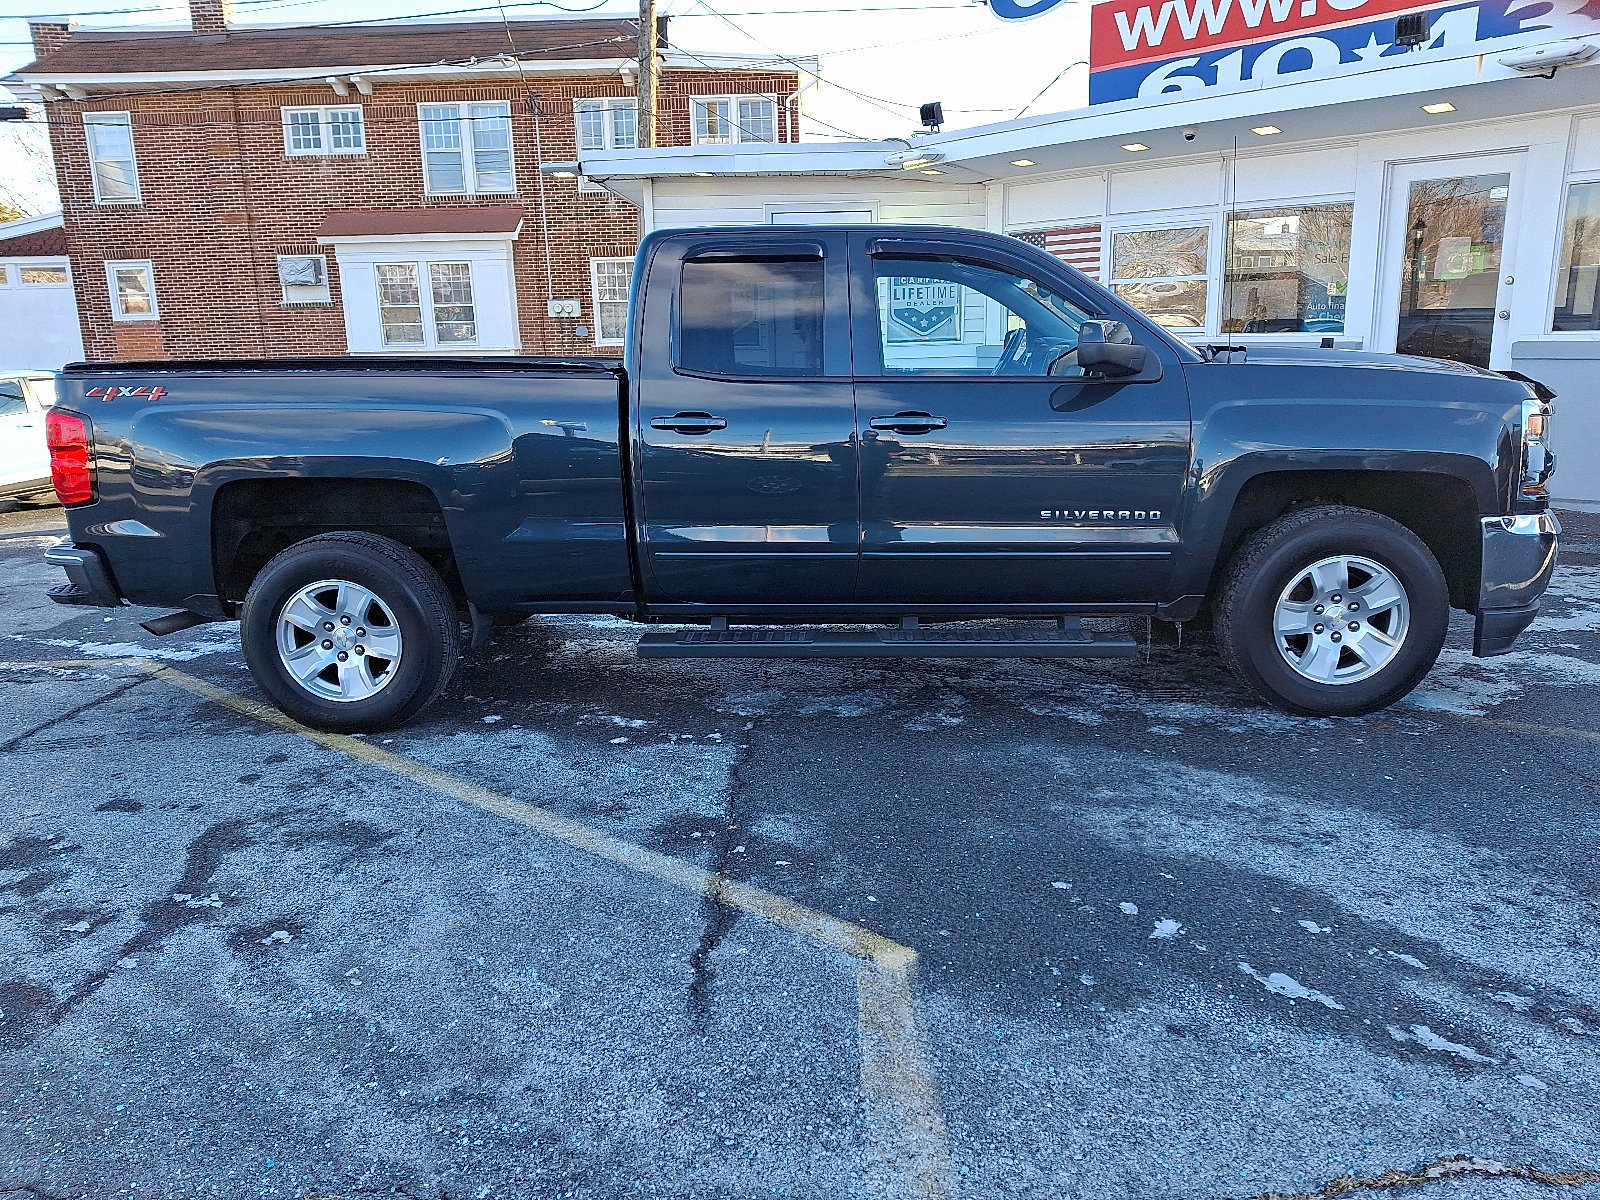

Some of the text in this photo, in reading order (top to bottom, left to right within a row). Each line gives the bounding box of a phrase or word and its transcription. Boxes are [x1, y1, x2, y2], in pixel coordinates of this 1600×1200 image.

[1137, 37, 1342, 99] 610
[1314, 253, 1338, 264] Sale
[893, 286, 955, 300] LIFETIME
[1307, 301, 1326, 310] Auto
[1040, 510, 1162, 520] SILVERADO
